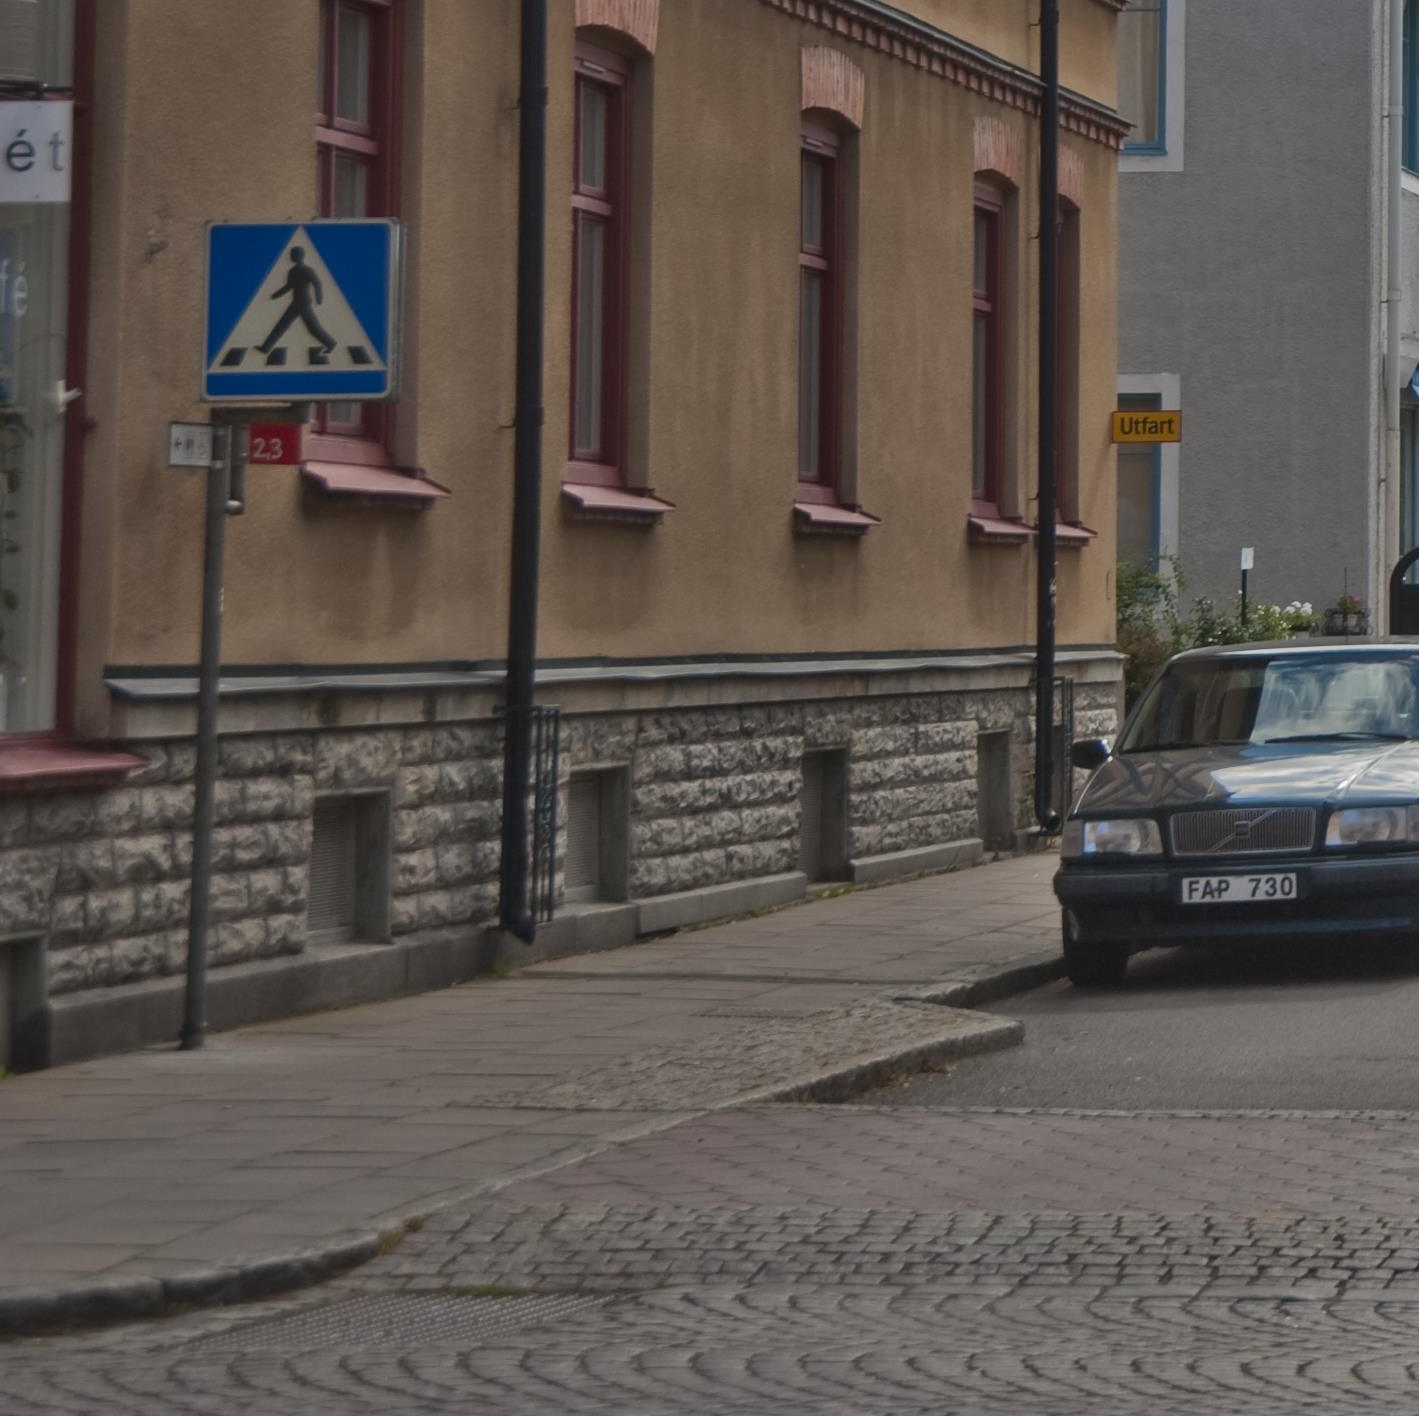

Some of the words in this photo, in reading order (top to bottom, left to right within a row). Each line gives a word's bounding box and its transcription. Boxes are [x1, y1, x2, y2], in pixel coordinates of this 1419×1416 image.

[1120, 417, 1175, 434] Utfart
[253, 437, 283, 460] 2,3
[1188, 879, 1230, 900] FAP
[1248, 876, 1293, 898] 730
